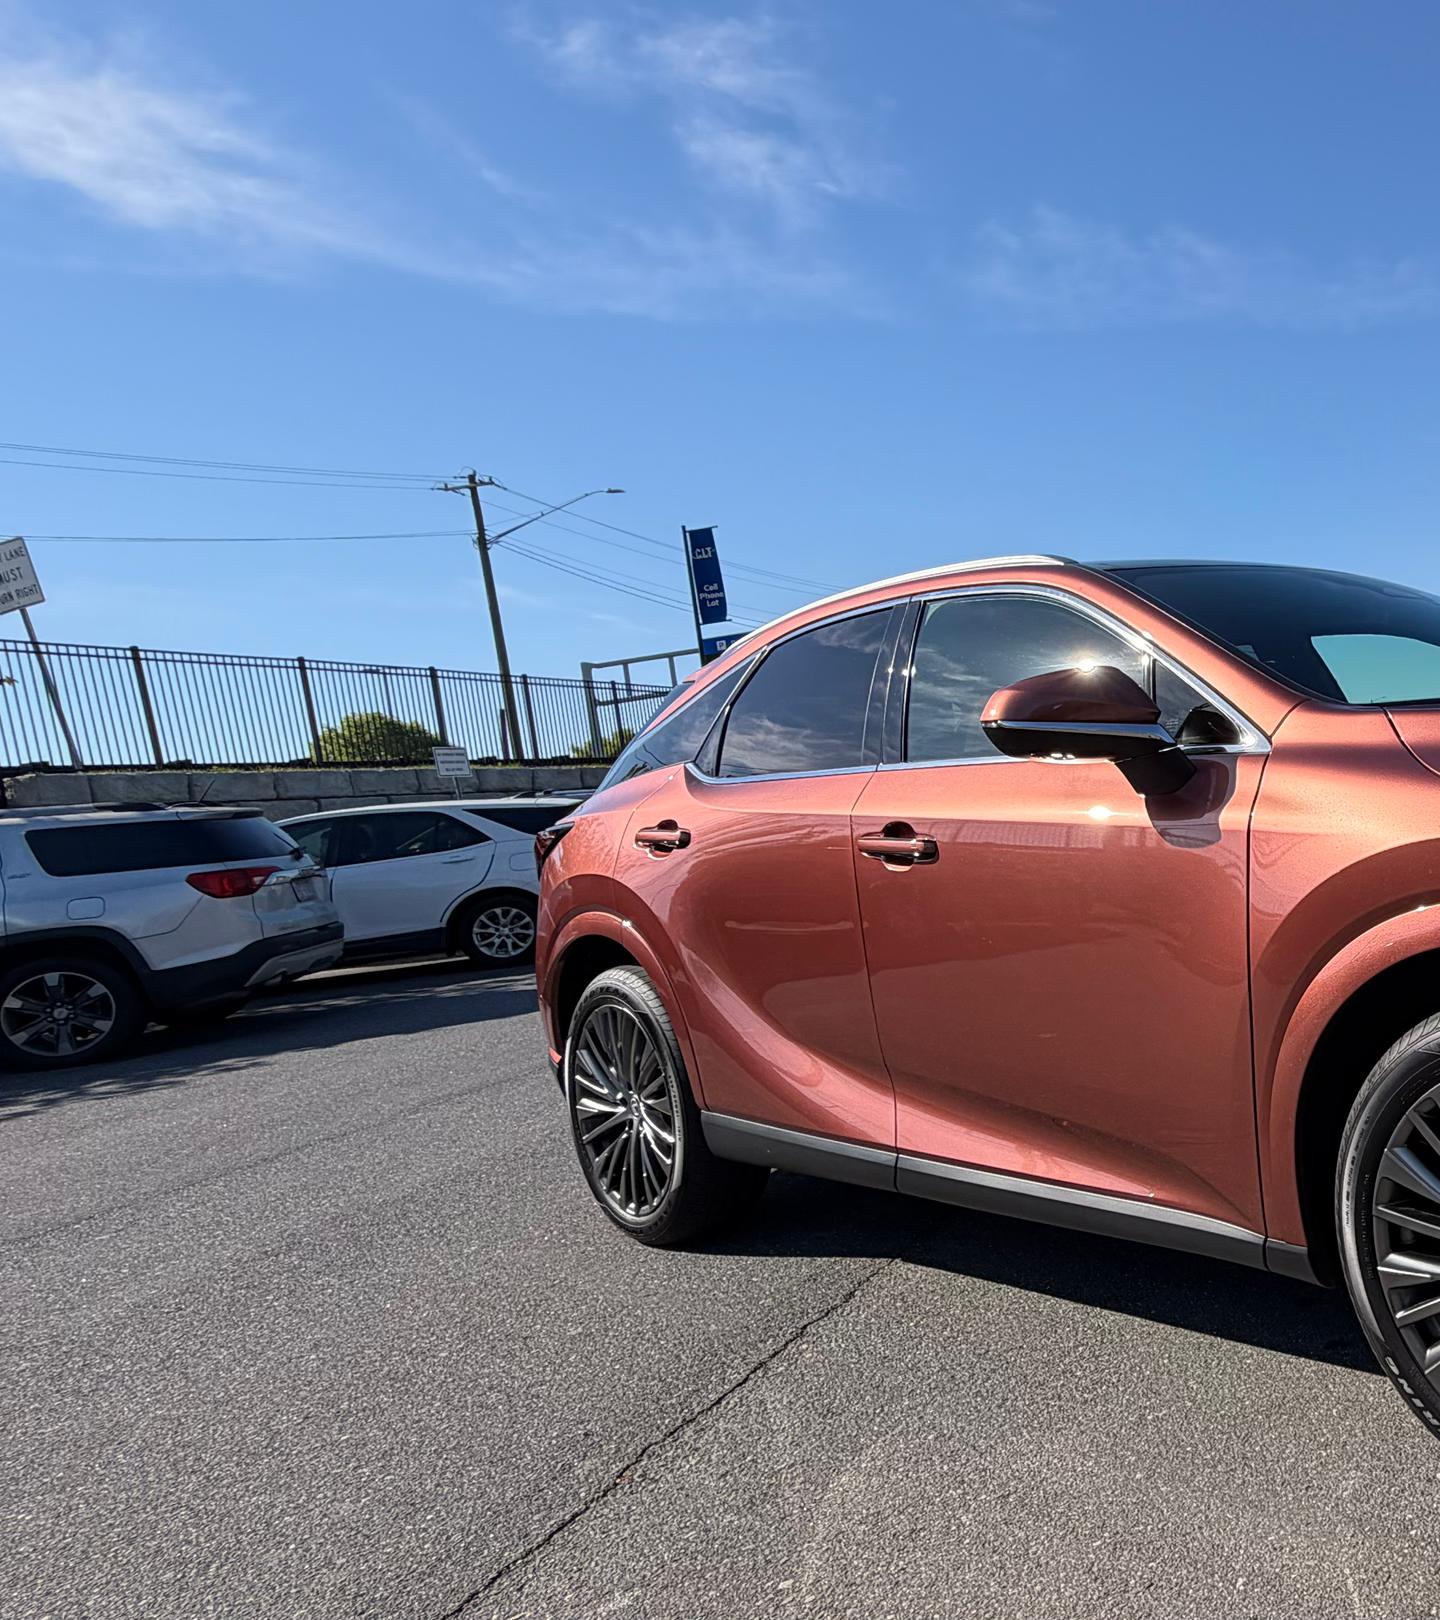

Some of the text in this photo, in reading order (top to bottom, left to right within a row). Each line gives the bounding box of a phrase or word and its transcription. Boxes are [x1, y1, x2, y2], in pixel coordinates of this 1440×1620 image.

[4, 546, 26, 561] LANE
[0, 584, 39, 605] URN RIGHT
